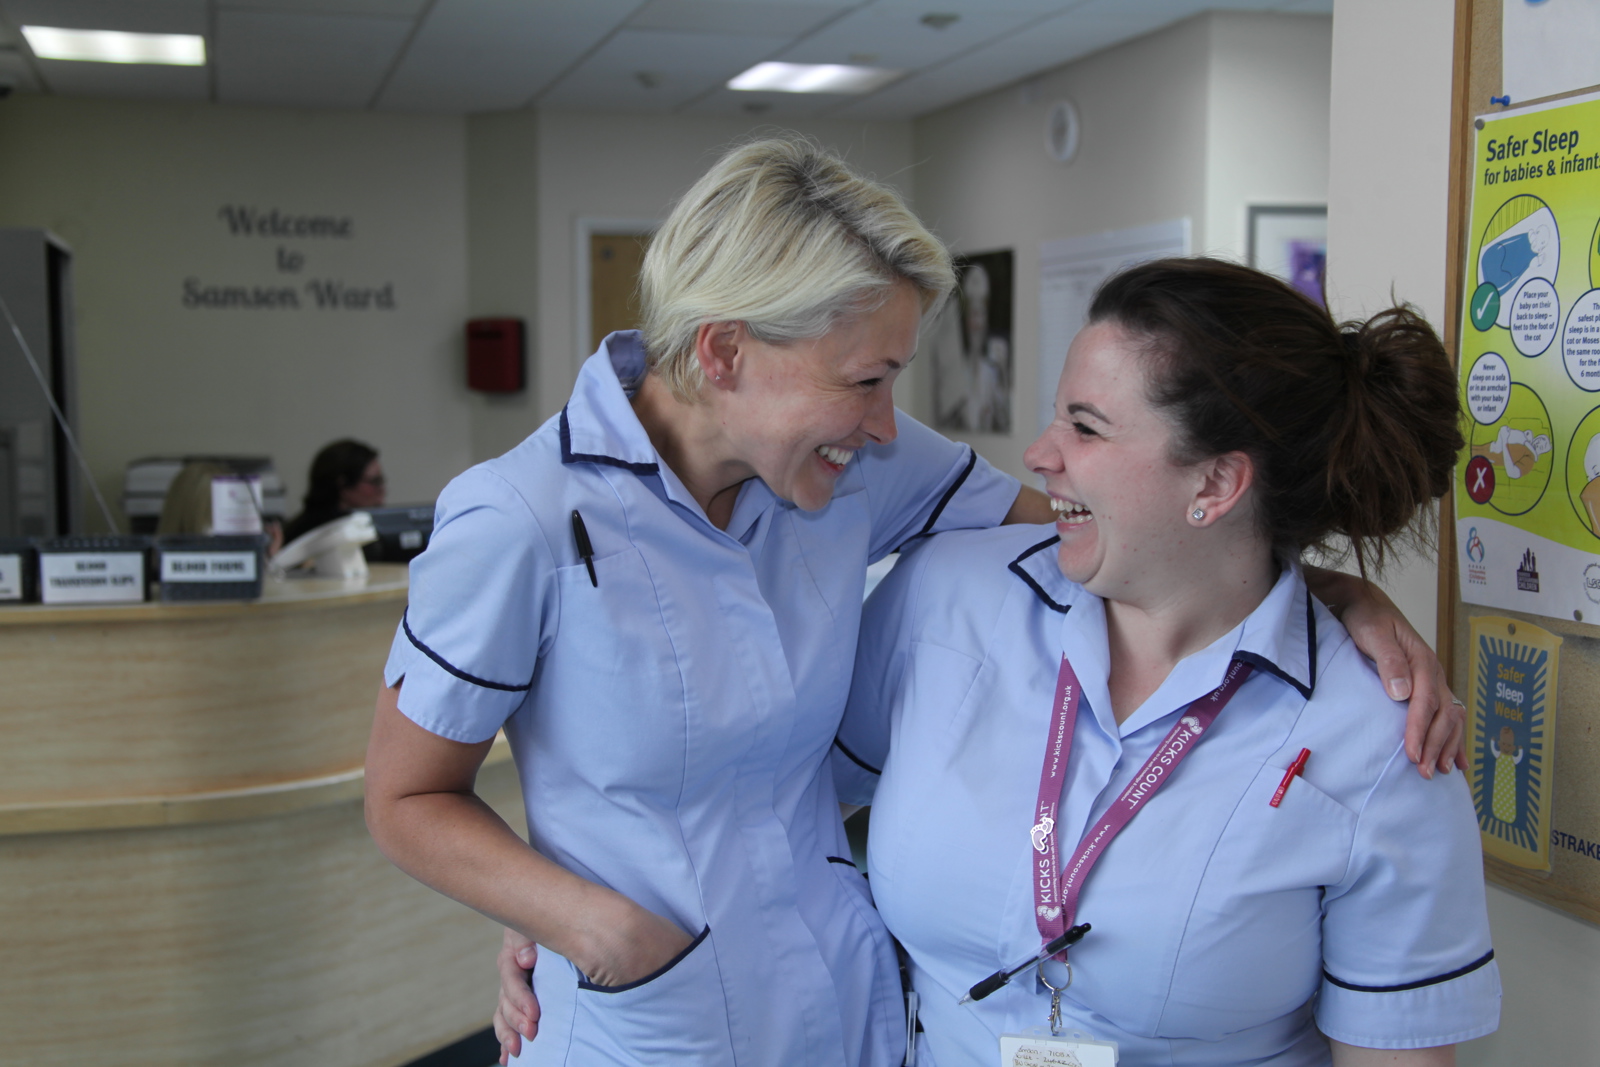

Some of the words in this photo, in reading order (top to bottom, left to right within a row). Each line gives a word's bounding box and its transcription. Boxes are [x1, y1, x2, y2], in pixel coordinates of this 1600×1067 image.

[1486, 135, 1529, 162] Safer
[1532, 128, 1579, 155] Sleep
[1484, 168, 1500, 186] for
[1503, 162, 1543, 183] babies
[1546, 160, 1556, 176] &
[1560, 152, 1600, 174] infant
[217, 203, 354, 239] Welcome
[276, 245, 304, 274] to
[304, 278, 395, 310] Ward
[1520, 302, 1530, 310] baby
[1569, 326, 1583, 334] sleep
[1578, 314, 1594, 322] safest
[1497, 664, 1526, 684] Safer
[1496, 682, 1524, 706] Sleep
[1495, 701, 1524, 723] Week
[1050, 686, 1072, 778] www.kickscount.org.uk
[1161, 730, 1192, 765] KICKS
[1039, 859, 1051, 903] KICKS
